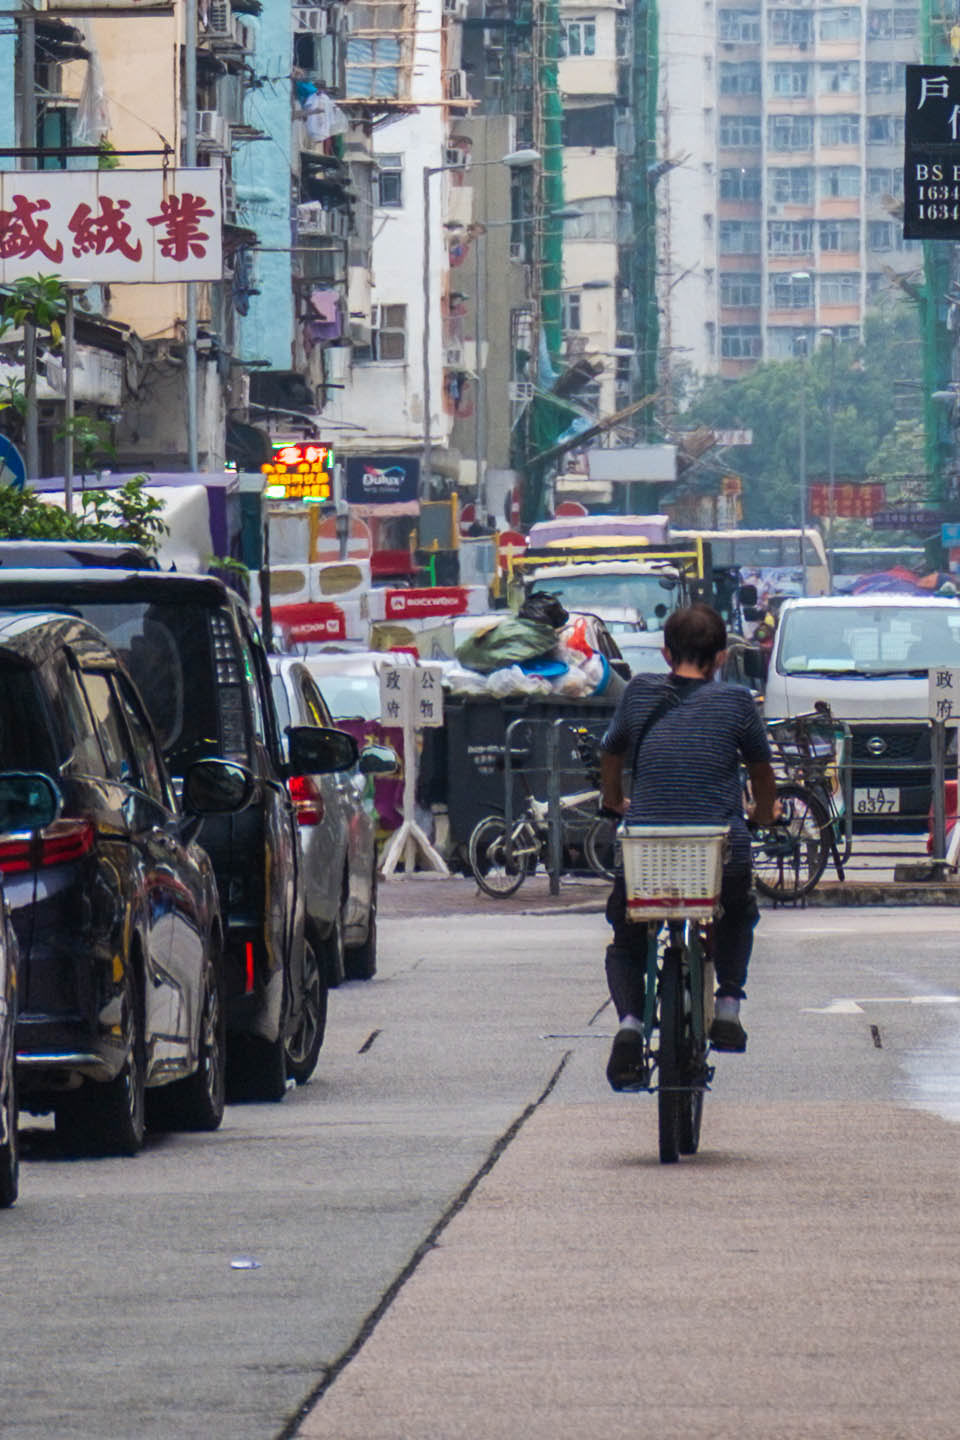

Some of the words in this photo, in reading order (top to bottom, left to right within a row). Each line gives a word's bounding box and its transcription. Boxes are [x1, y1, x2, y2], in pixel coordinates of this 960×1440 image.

[916, 164, 943, 181] BS
[362, 473, 400, 486] Dulux
[935, 670, 954, 721] 政府
[857, 799, 896, 814] 8377
